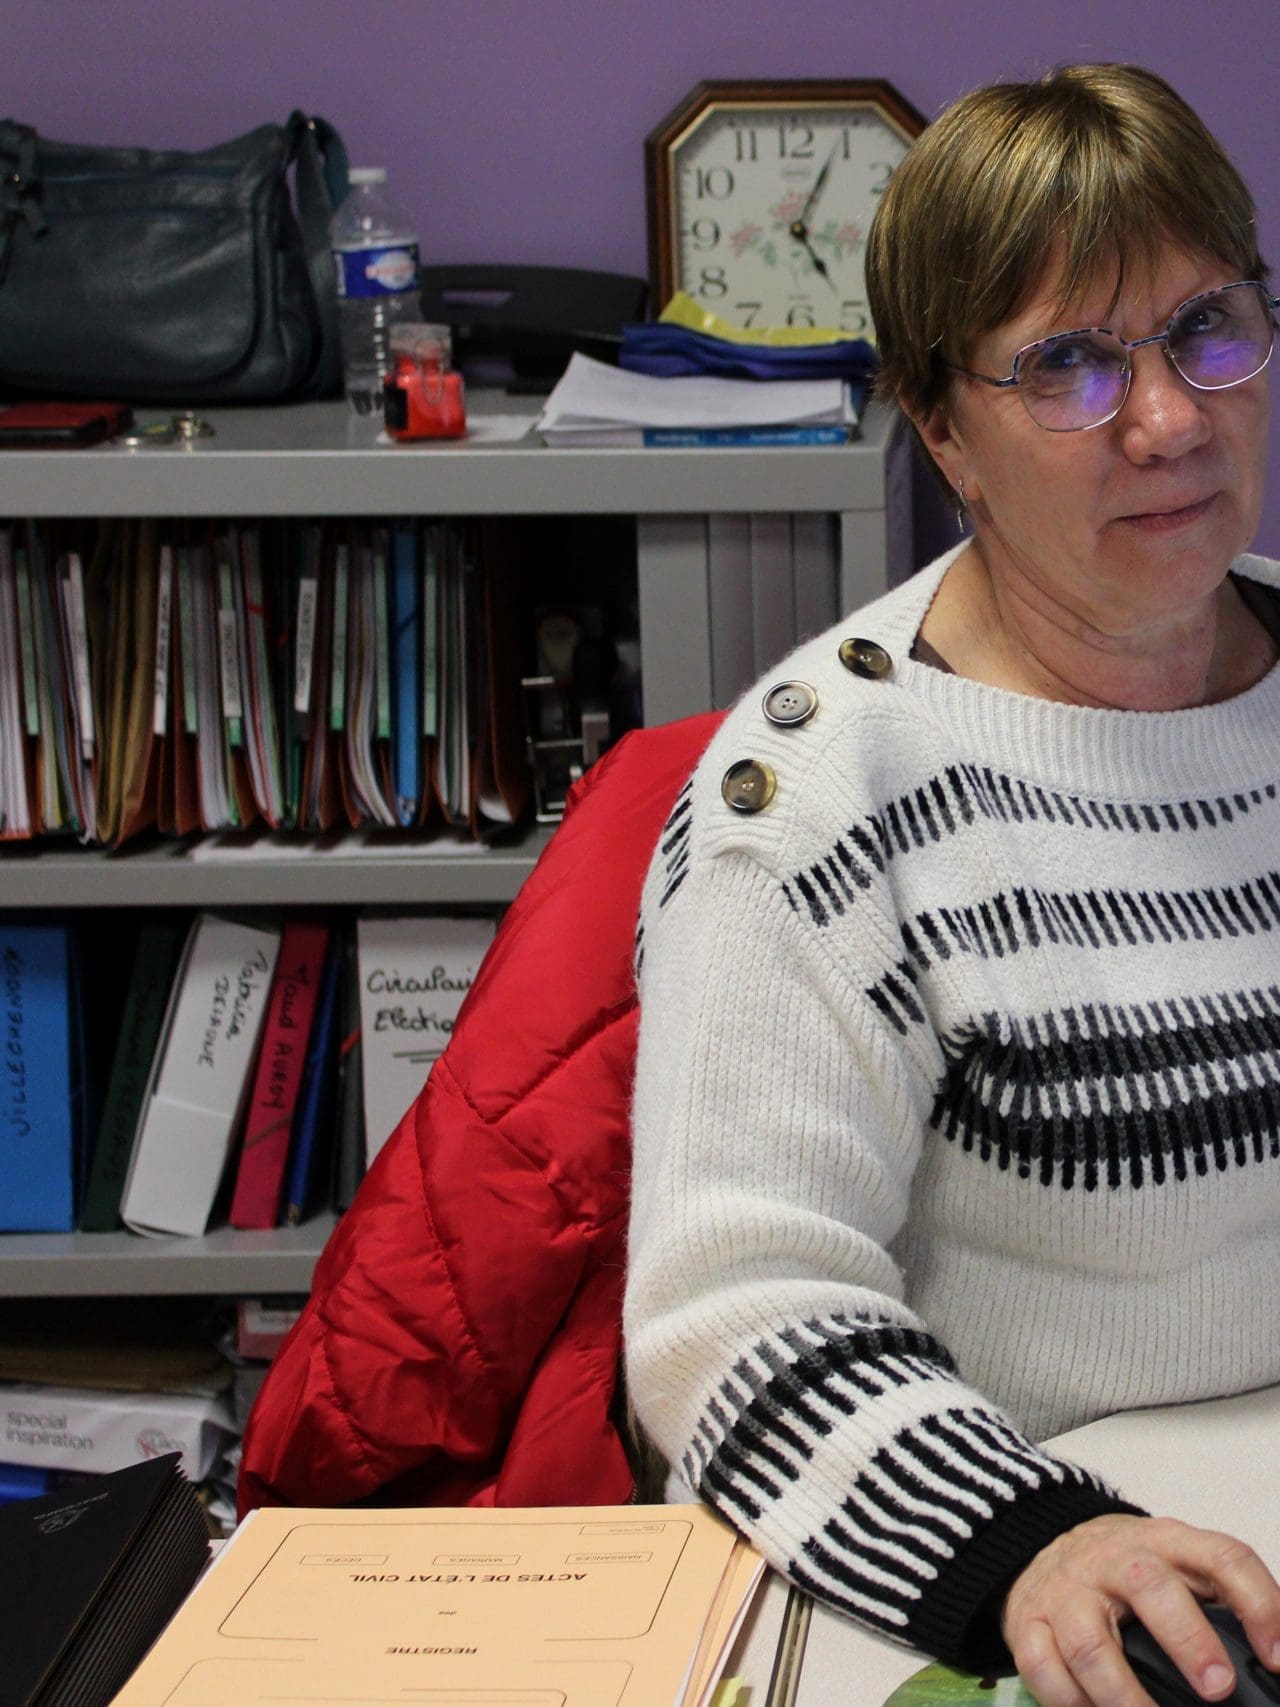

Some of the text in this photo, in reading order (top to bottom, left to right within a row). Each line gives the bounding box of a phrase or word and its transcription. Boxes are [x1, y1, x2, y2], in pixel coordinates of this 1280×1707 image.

[735, 129, 757, 161] 11
[778, 126, 815, 159] 12
[840, 128, 851, 160] 1
[696, 166, 735, 200] 10
[869, 162, 894, 194] 2
[692, 217, 721, 251] 9
[699, 266, 729, 299] 8
[735, 302, 762, 329] 7
[786, 304, 816, 328] 6
[839, 300, 867, 332] 5
[7, 1411, 67, 1430] special
[7, 1430, 95, 1450] inspiration
[349, 1573, 588, 1585] ACTES DE L'ÉTAT CIVIL
[385, 1646, 477, 1655] REGISTRE
